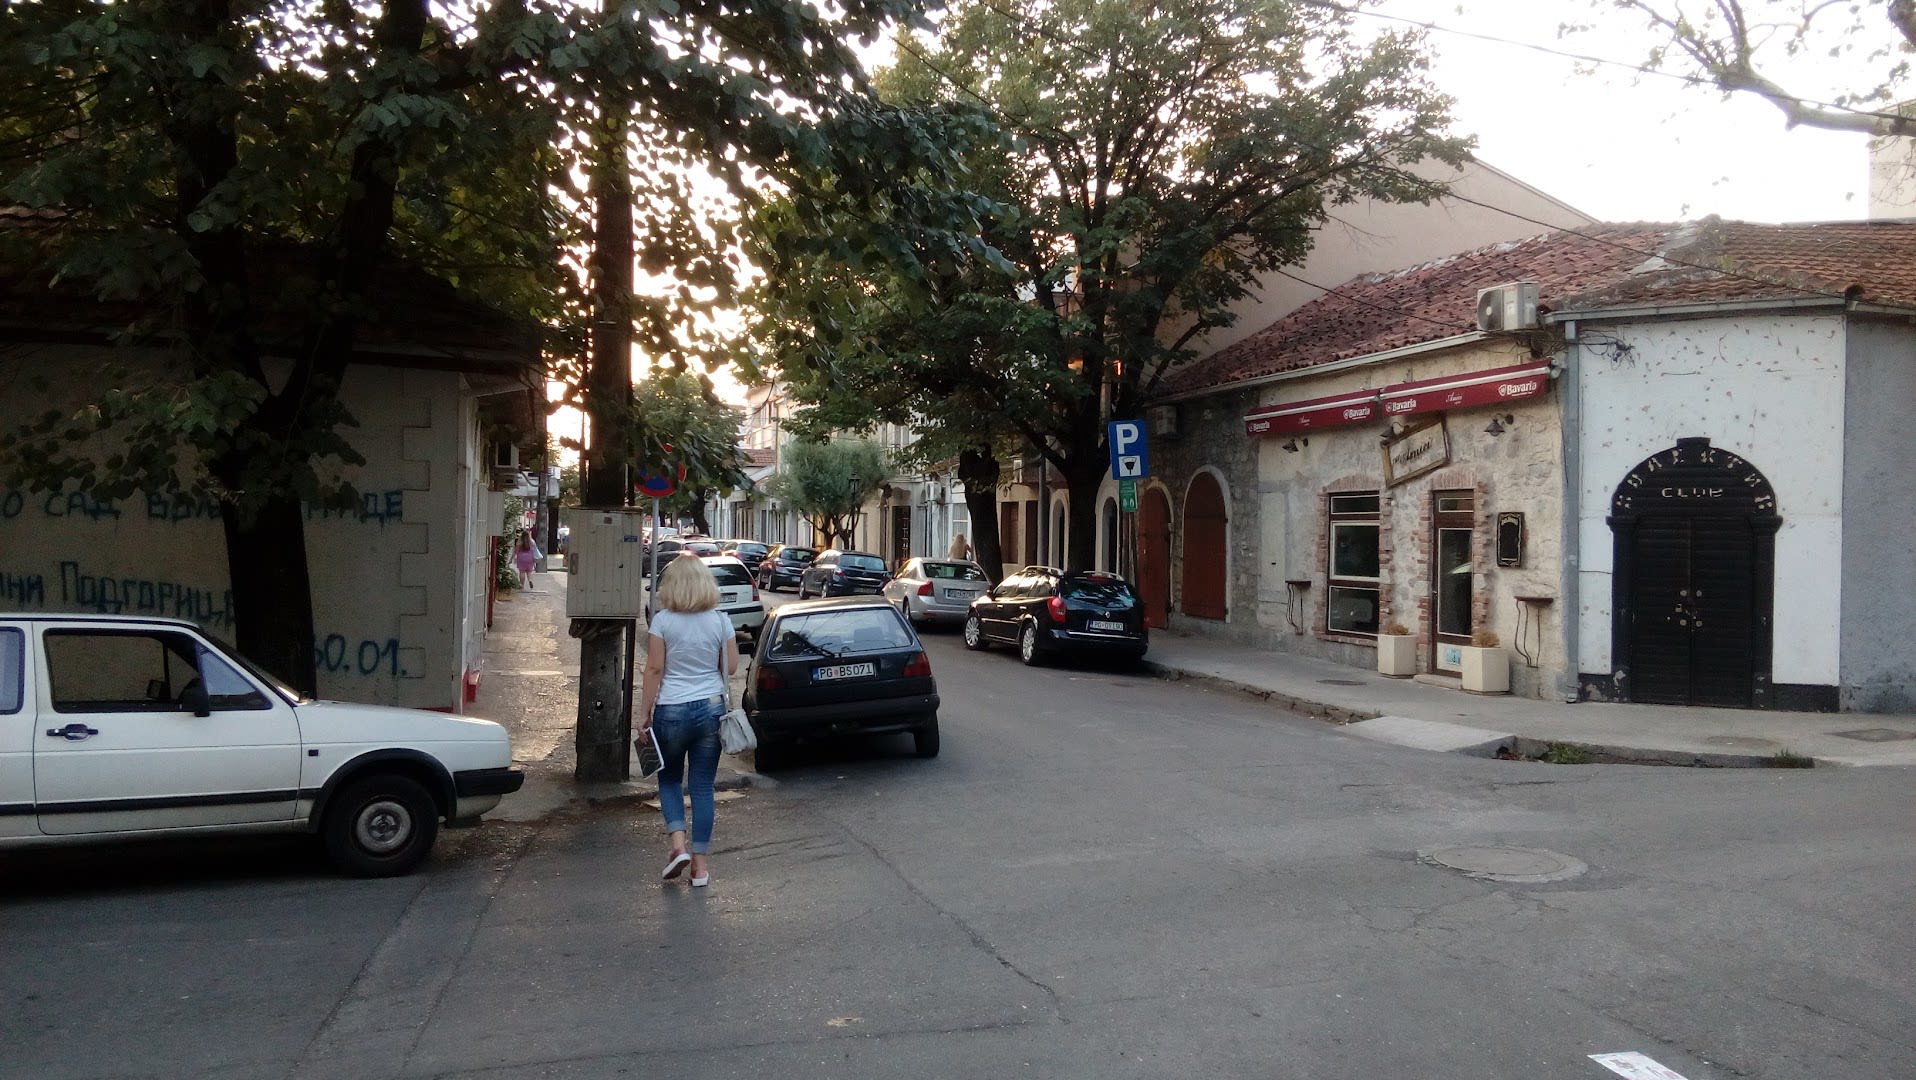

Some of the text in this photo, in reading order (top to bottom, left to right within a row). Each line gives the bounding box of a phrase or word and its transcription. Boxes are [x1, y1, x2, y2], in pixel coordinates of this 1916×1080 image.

[1507, 381, 1537, 395] Bavaria
[1392, 399, 1417, 411] Bavaria
[1116, 423, 1139, 454] P
[820, 664, 873, 678] PG BS071
